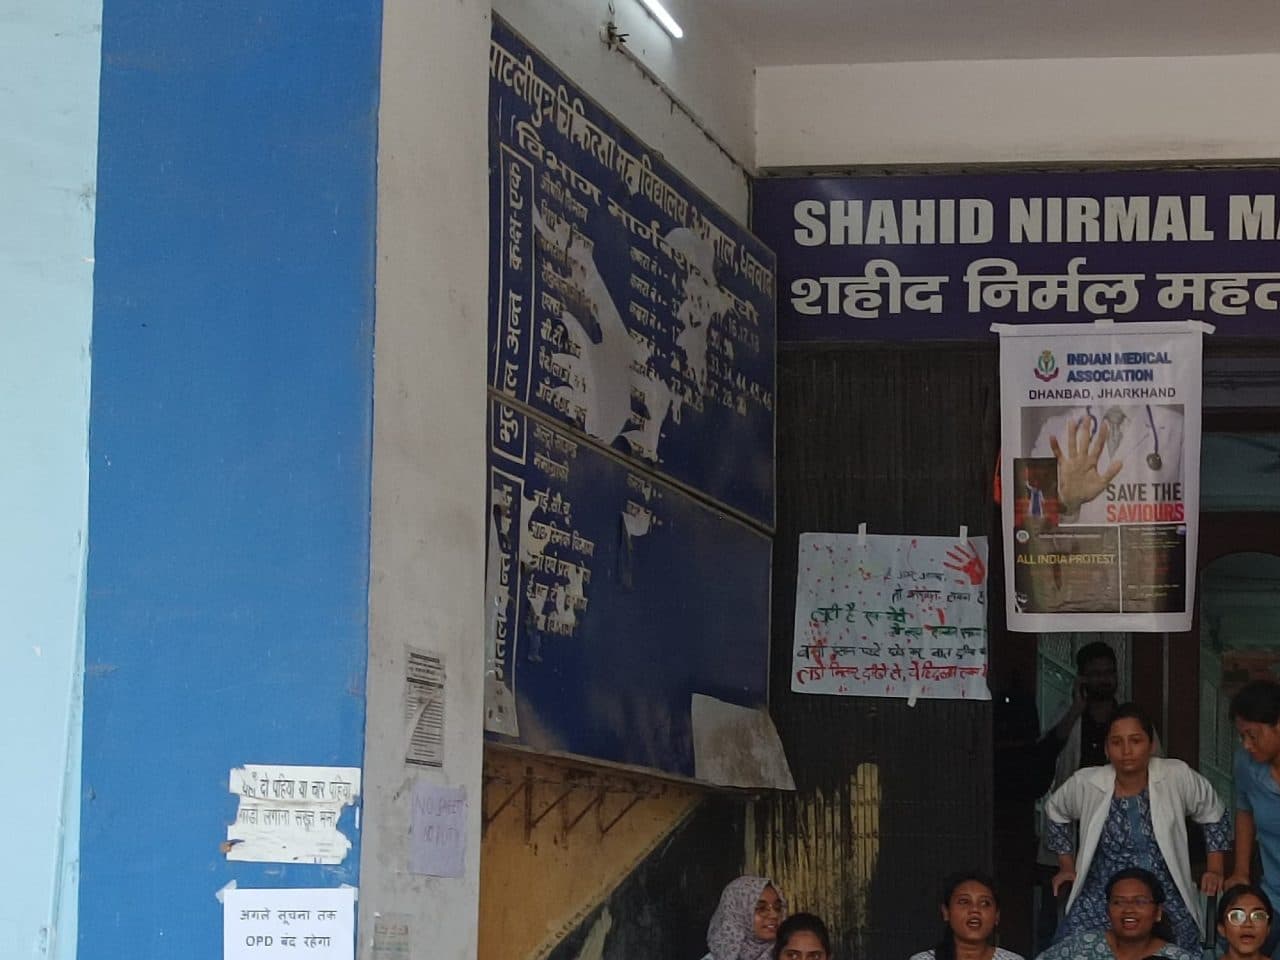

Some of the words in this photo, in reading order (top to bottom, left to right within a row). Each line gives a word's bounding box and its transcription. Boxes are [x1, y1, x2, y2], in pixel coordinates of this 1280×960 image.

[793, 198, 994, 247] SHAHID
[1009, 195, 1215, 244] NIRMAL
[791, 259, 949, 319] शहीद
[963, 257, 1145, 315] निर्मल
[1067, 352, 1112, 366] INDIAN
[1114, 351, 1172, 365] MEDICAL
[1066, 368, 1154, 382] ASSOCIATION
[1029, 388, 1093, 400] DHANBAD,
[1097, 386, 1176, 399] JHARKHAND
[1106, 482, 1147, 502] SAVE
[1152, 482, 1182, 501] THE
[1106, 502, 1185, 523] SAVIOURS
[1017, 554, 1037, 565] ALL
[1038, 554, 1067, 565] INDIA
[1068, 553, 1116, 565] PROTEST
[239, 907, 271, 921] अगले
[278, 909, 310, 925] सूचना
[317, 909, 337, 921] तक
[246, 935, 274, 947] OPD
[280, 932, 296, 948] बंद
[303, 934, 331, 949] रहेगा
